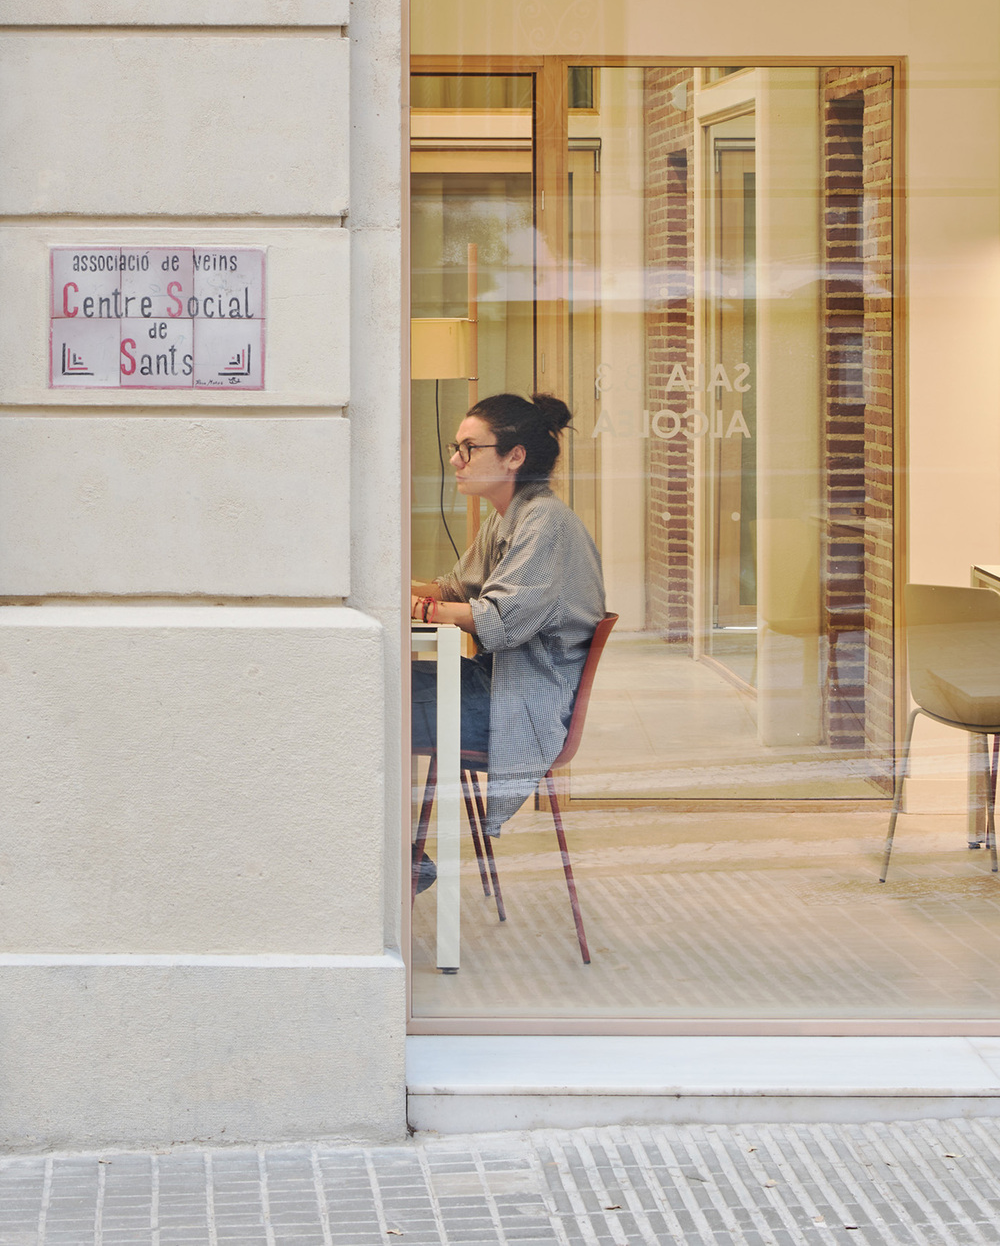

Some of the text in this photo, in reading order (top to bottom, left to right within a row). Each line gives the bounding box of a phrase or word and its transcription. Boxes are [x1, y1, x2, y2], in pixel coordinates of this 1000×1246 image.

[72, 251, 238, 272] associació de veïns
[63, 281, 255, 319] Centre Social
[148, 322, 168, 339] de
[120, 338, 194, 376] Sants
